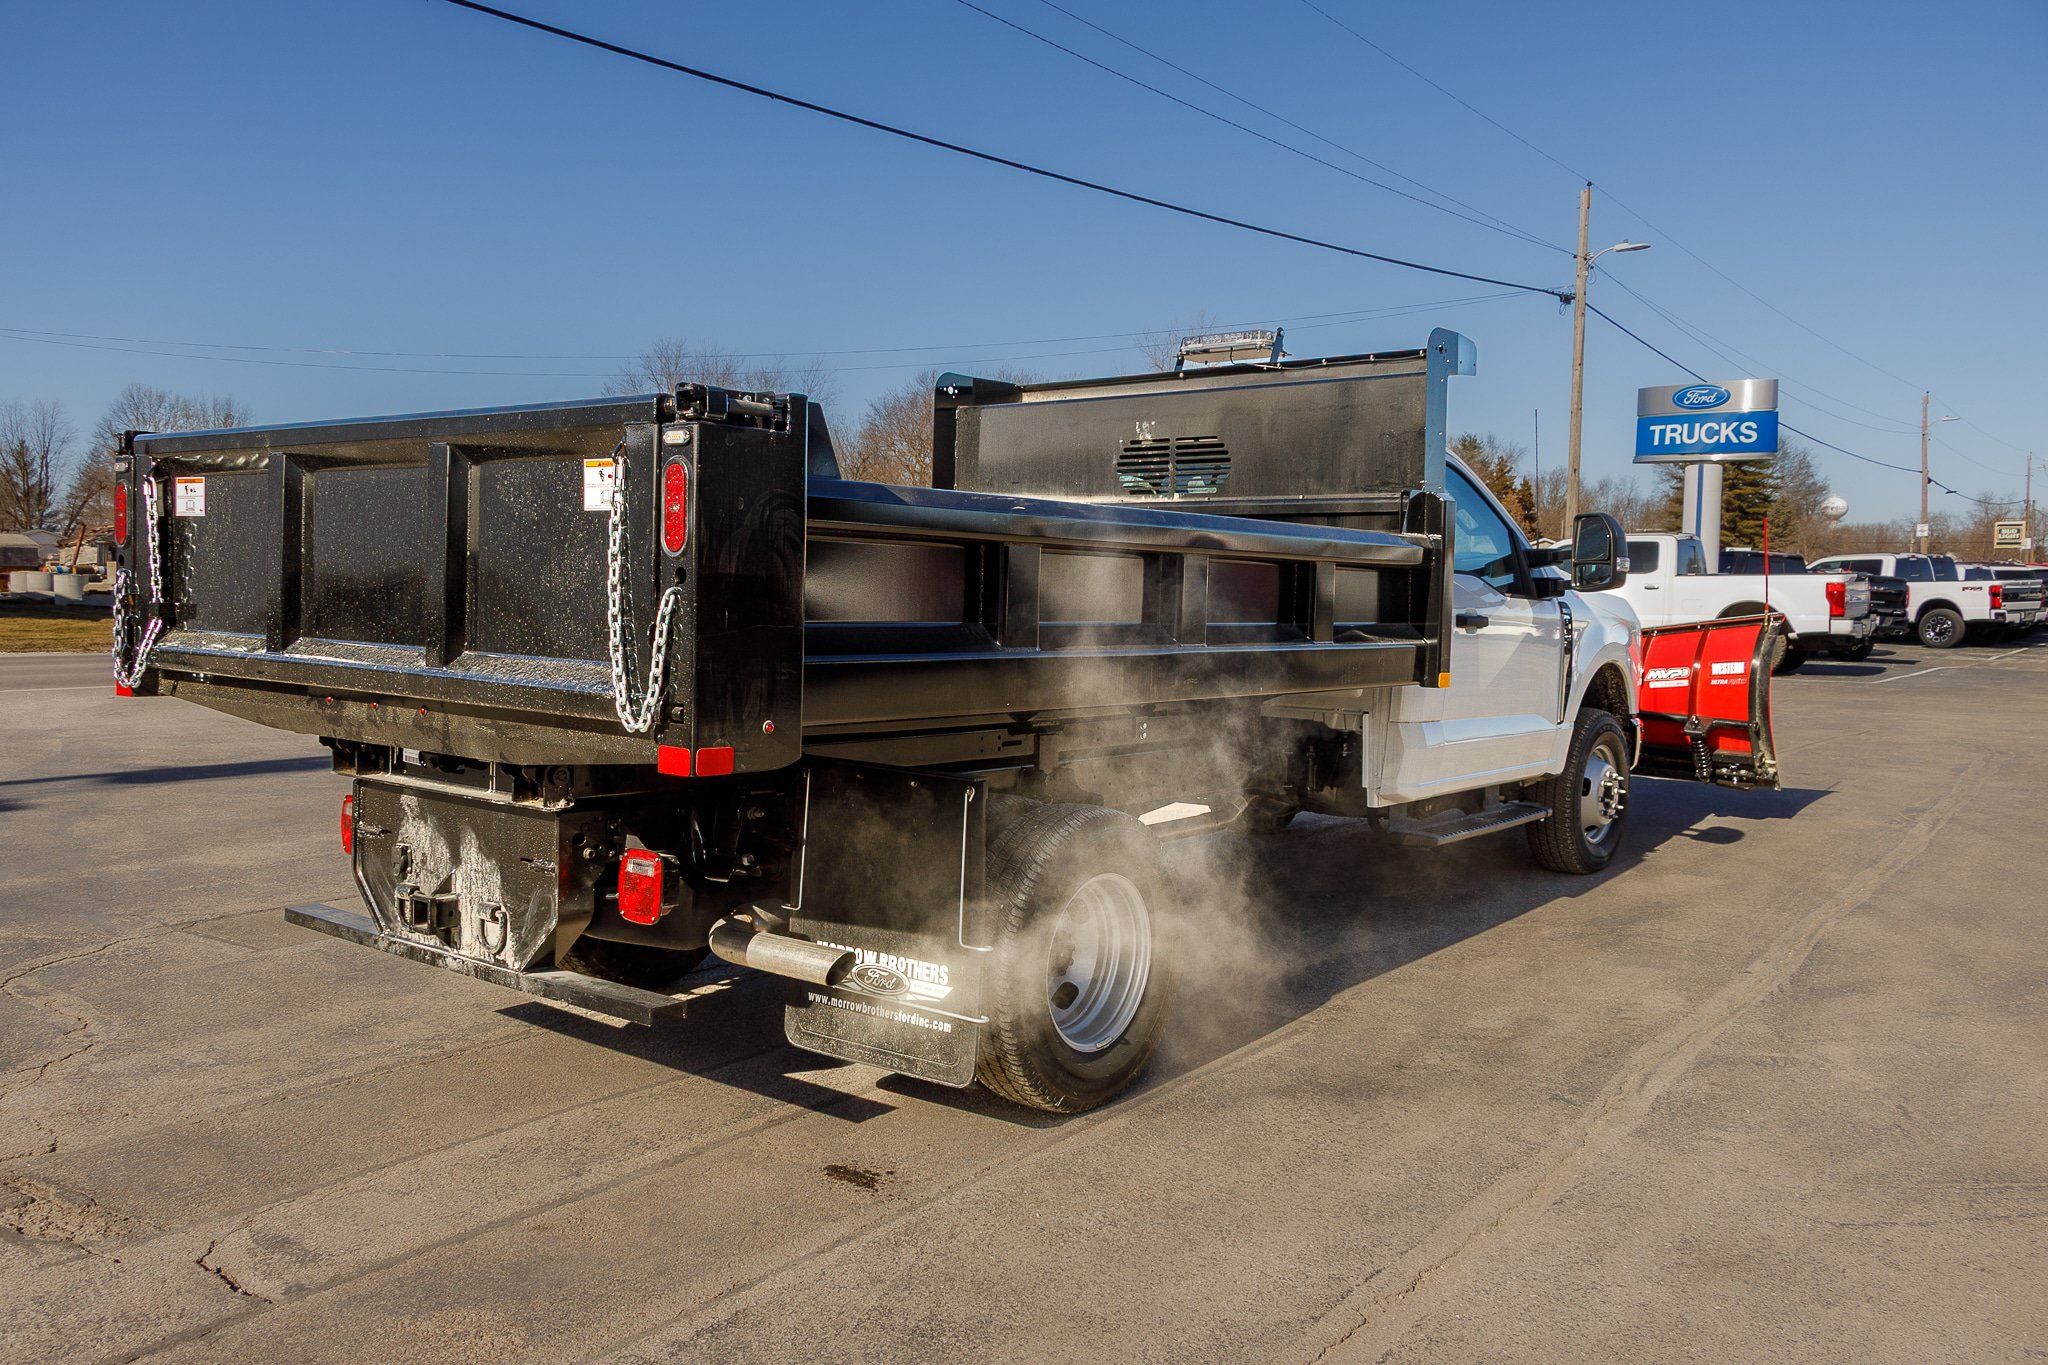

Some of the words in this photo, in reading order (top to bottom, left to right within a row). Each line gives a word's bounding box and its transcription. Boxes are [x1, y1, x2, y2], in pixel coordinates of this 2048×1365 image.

[1684, 389, 1717, 404] Ford
[1649, 421, 1758, 446] TRUCKS
[863, 968, 897, 990] Ford
[879, 953, 949, 986] BROTHERS
[807, 990, 952, 1033] www.morrowbrothersfordinc.com
